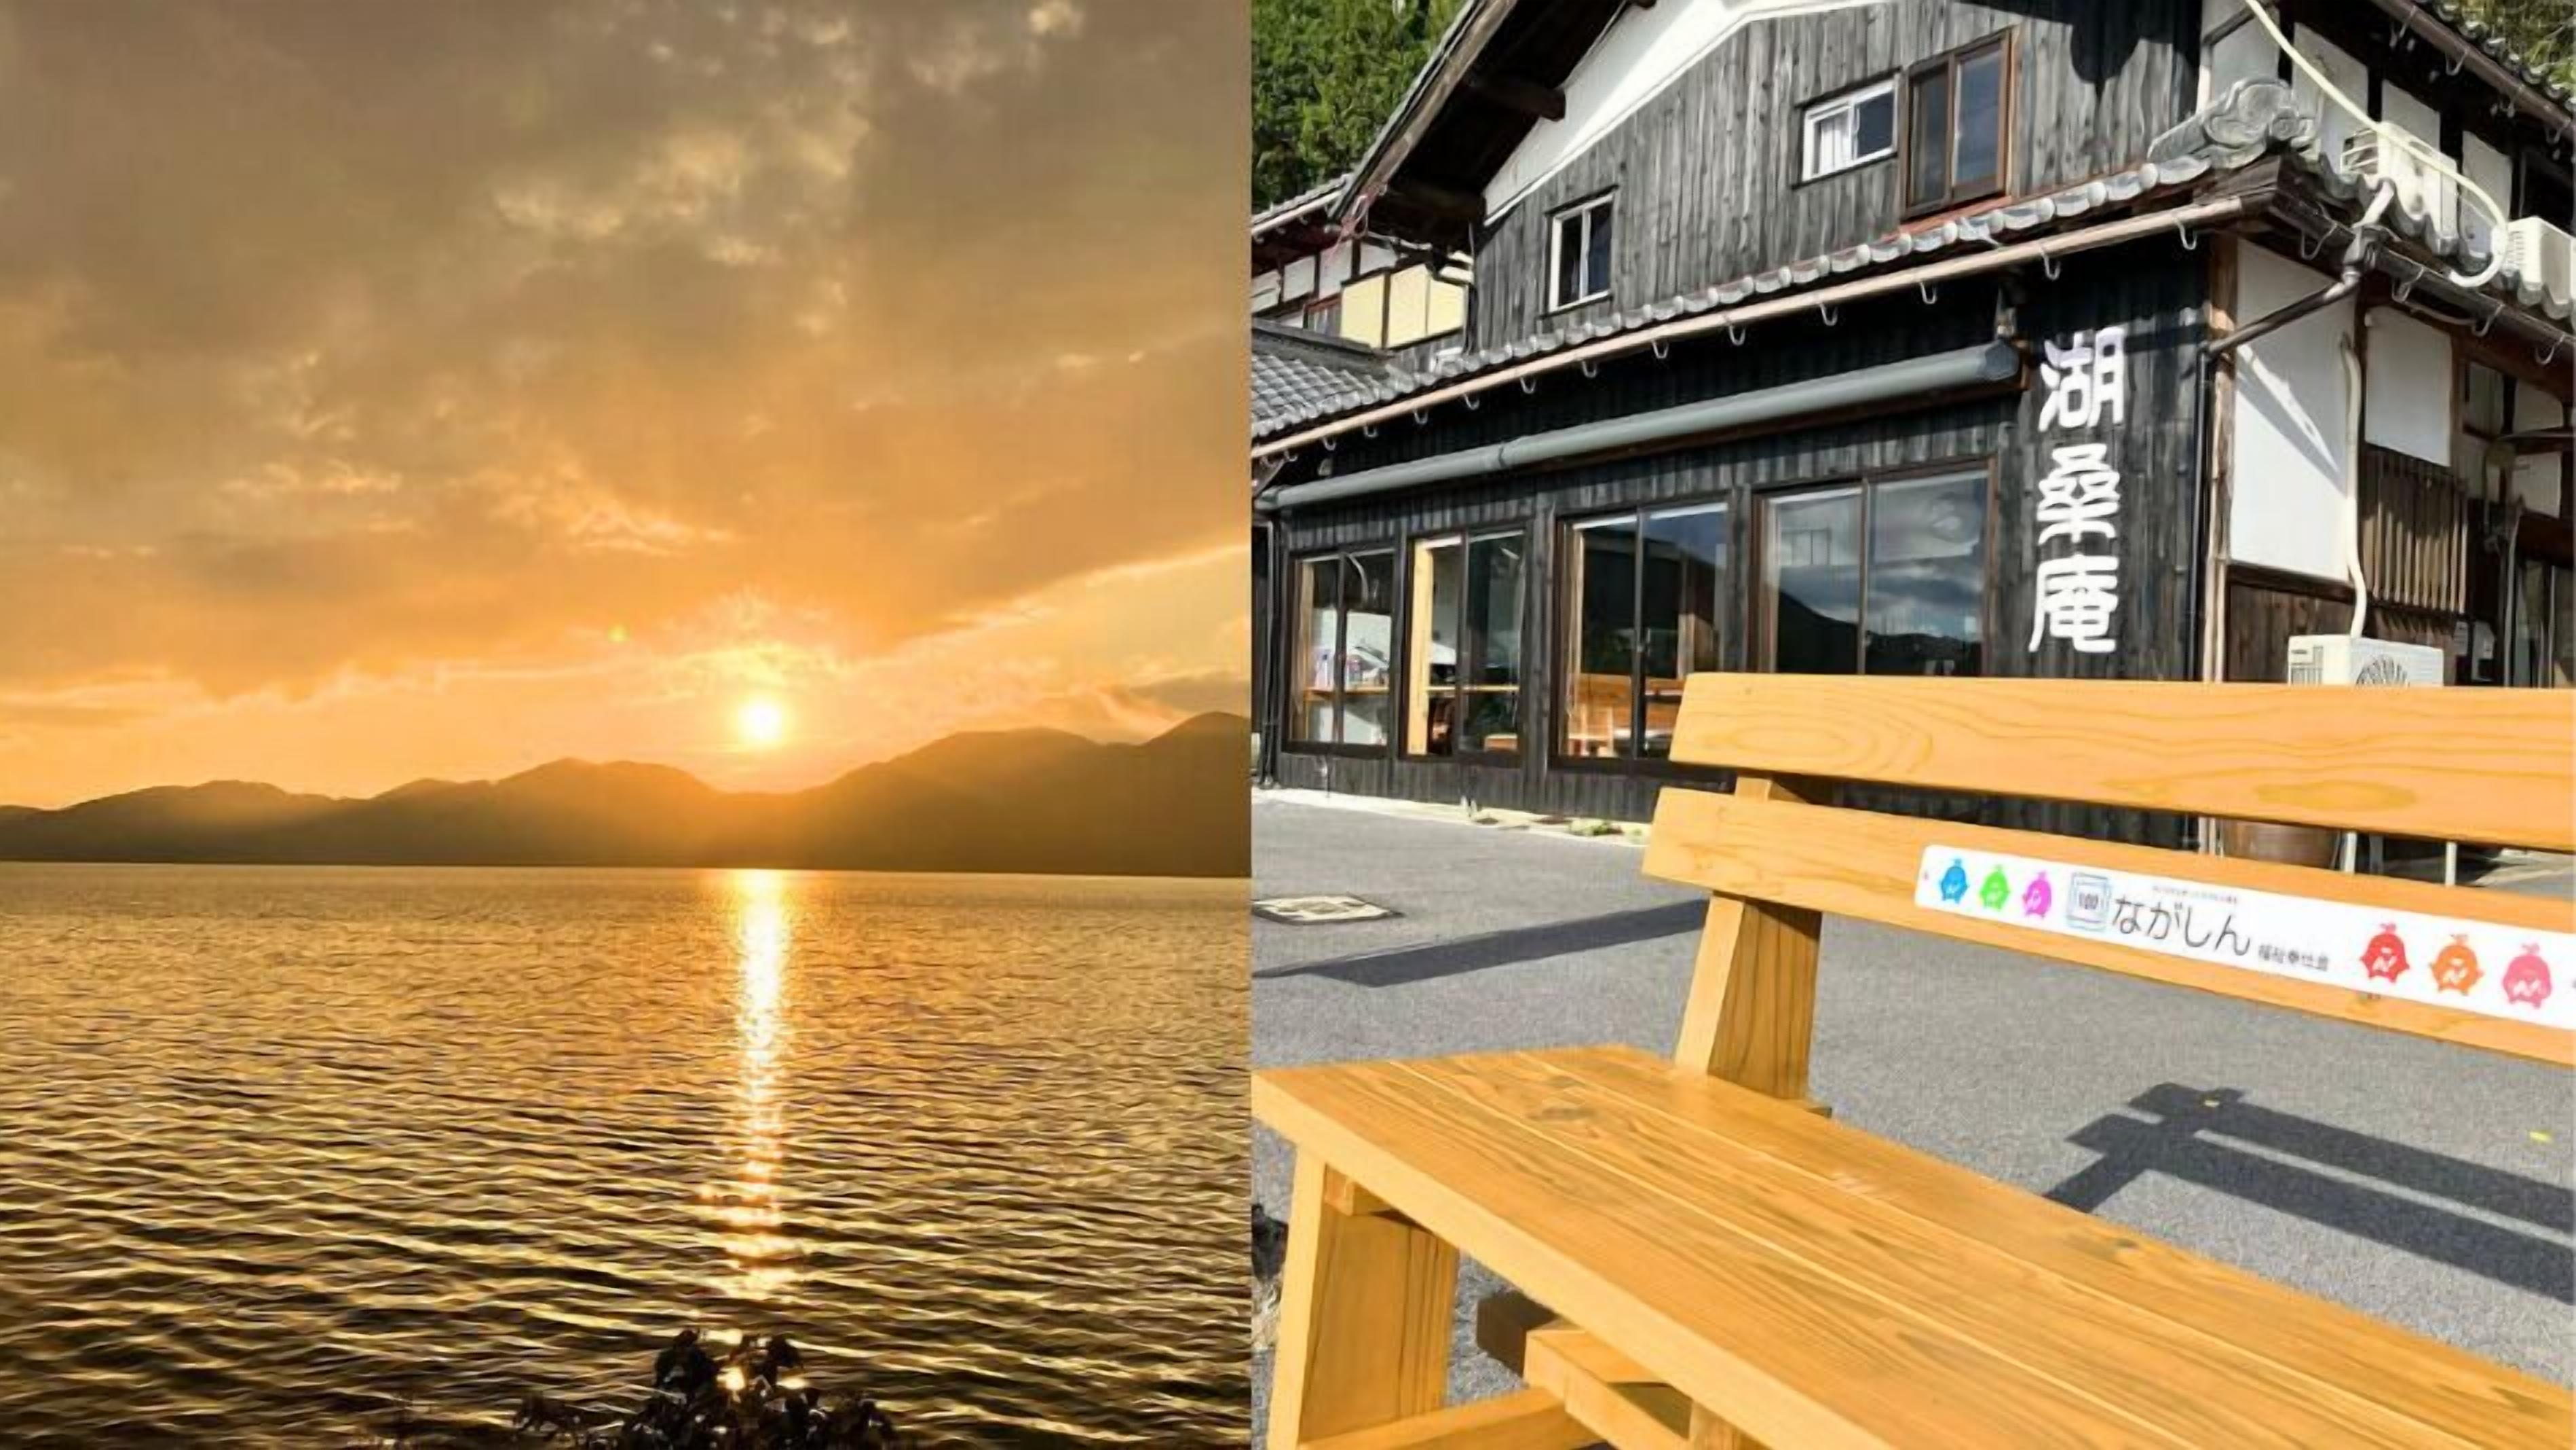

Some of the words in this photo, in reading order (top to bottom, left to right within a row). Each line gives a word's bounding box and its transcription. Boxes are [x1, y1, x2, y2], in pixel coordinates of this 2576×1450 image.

[2028, 326, 2126, 653] 湖桑庵
[2113, 894, 2250, 956] ながしん
